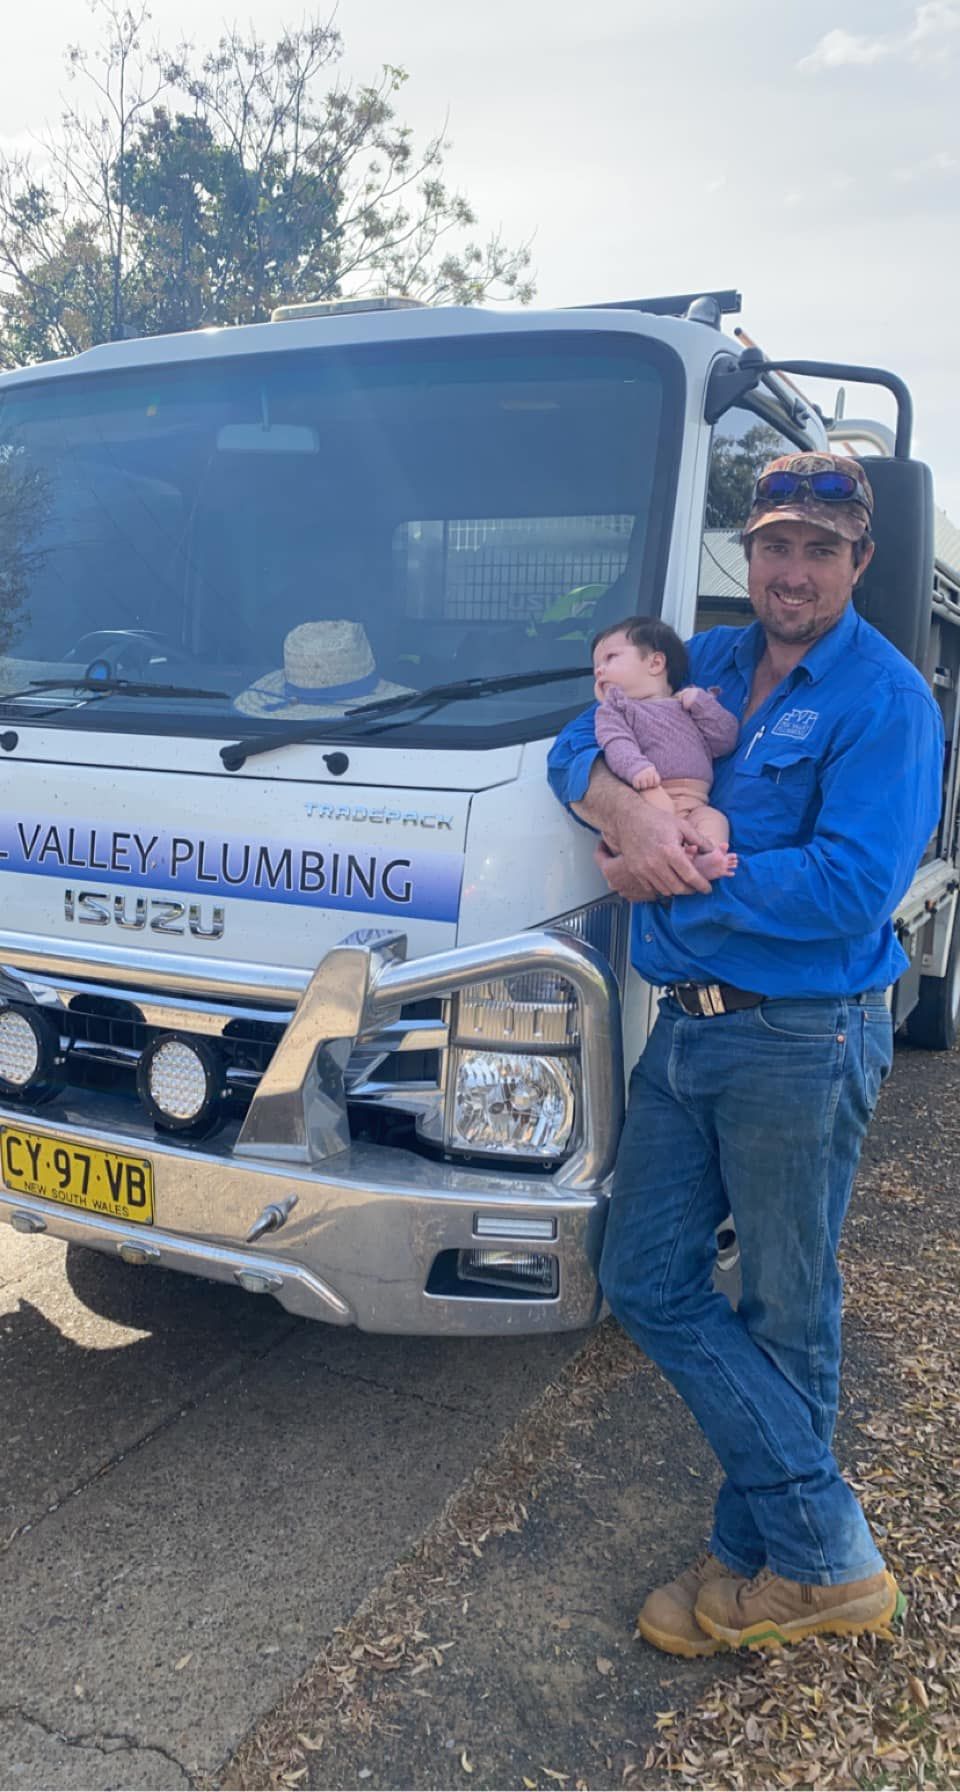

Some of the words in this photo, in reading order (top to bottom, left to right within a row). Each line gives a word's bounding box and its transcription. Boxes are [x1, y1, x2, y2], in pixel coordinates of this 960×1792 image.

[304, 801, 455, 830] TRADEPACK
[17, 822, 158, 874] VALLEY
[170, 838, 413, 903] PLUMBING
[64, 889, 225, 940] ISUZU
[24, 1180, 47, 1195] NEW
[51, 1188, 87, 1206] SOUTH
[93, 1199, 130, 1217] WALES
